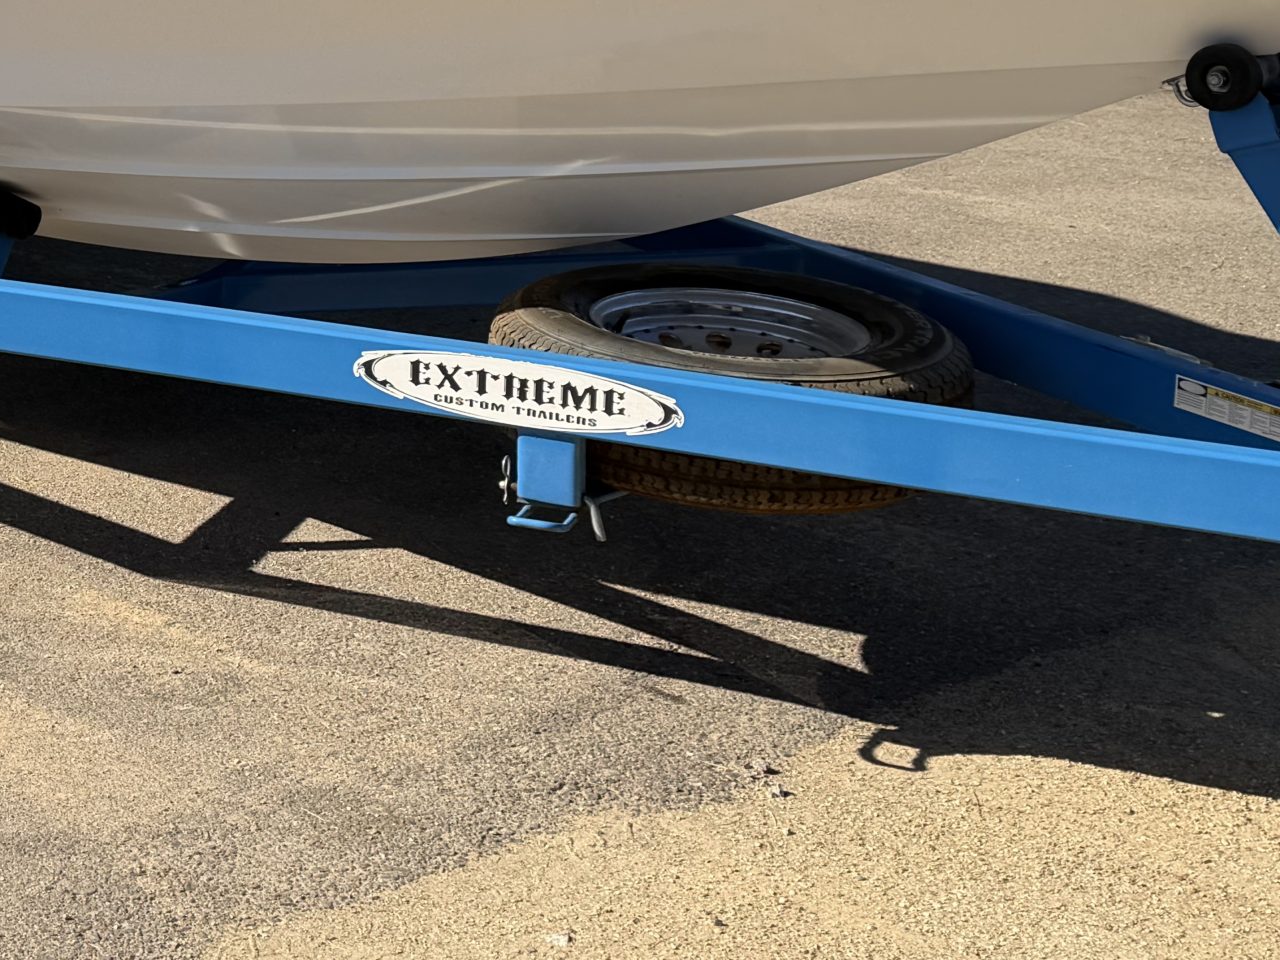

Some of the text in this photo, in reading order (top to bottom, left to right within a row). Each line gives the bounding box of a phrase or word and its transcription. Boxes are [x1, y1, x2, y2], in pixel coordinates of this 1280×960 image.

[409, 359, 626, 417] EXTREME
[434, 393, 598, 427] CUSTOM TRAILERS
